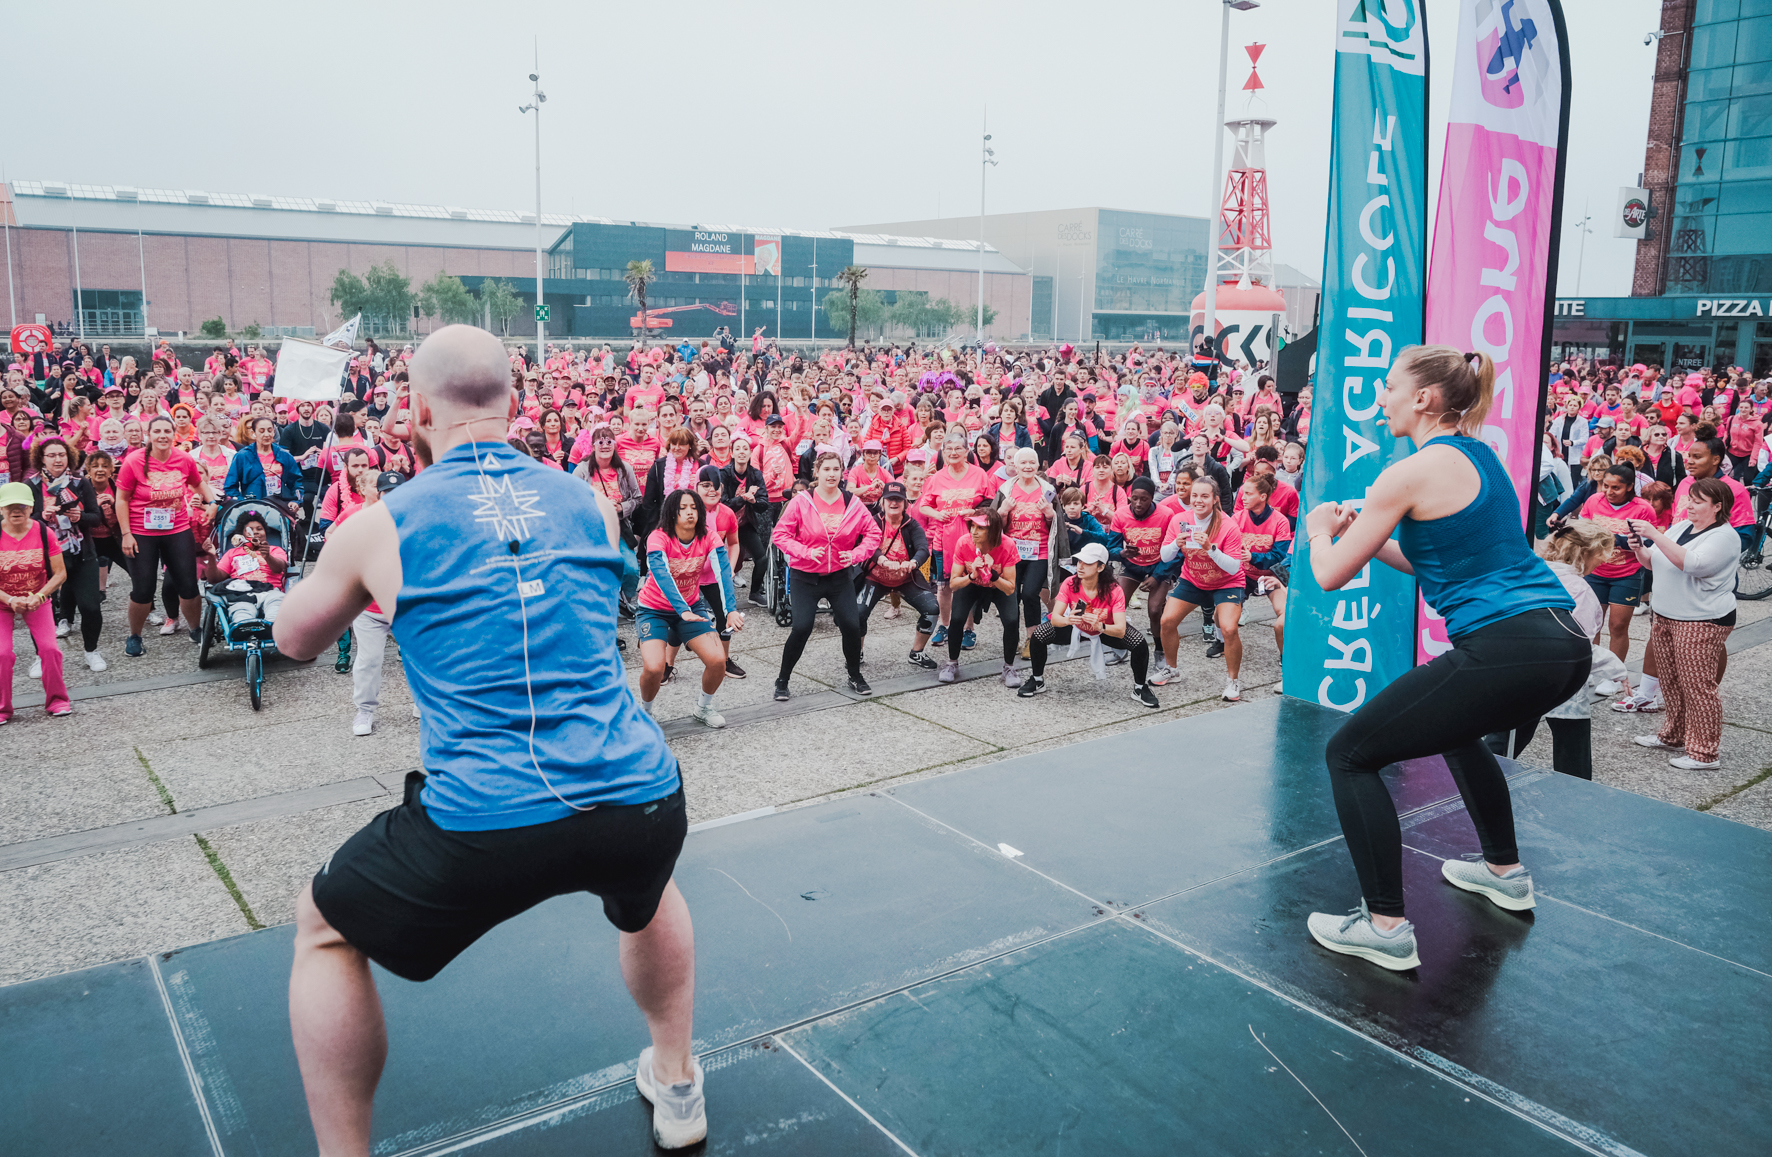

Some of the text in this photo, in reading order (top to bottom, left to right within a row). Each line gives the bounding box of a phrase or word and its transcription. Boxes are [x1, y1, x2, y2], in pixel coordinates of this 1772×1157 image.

[1057, 220, 1083, 233] CARRÉ
[694, 231, 728, 242] ROLAND
[1066, 231, 1092, 241] DOCKS
[691, 243, 731, 253] MAGDANE
[1696, 299, 1763, 317] PIZZA
[521, 582, 543, 595] LM
